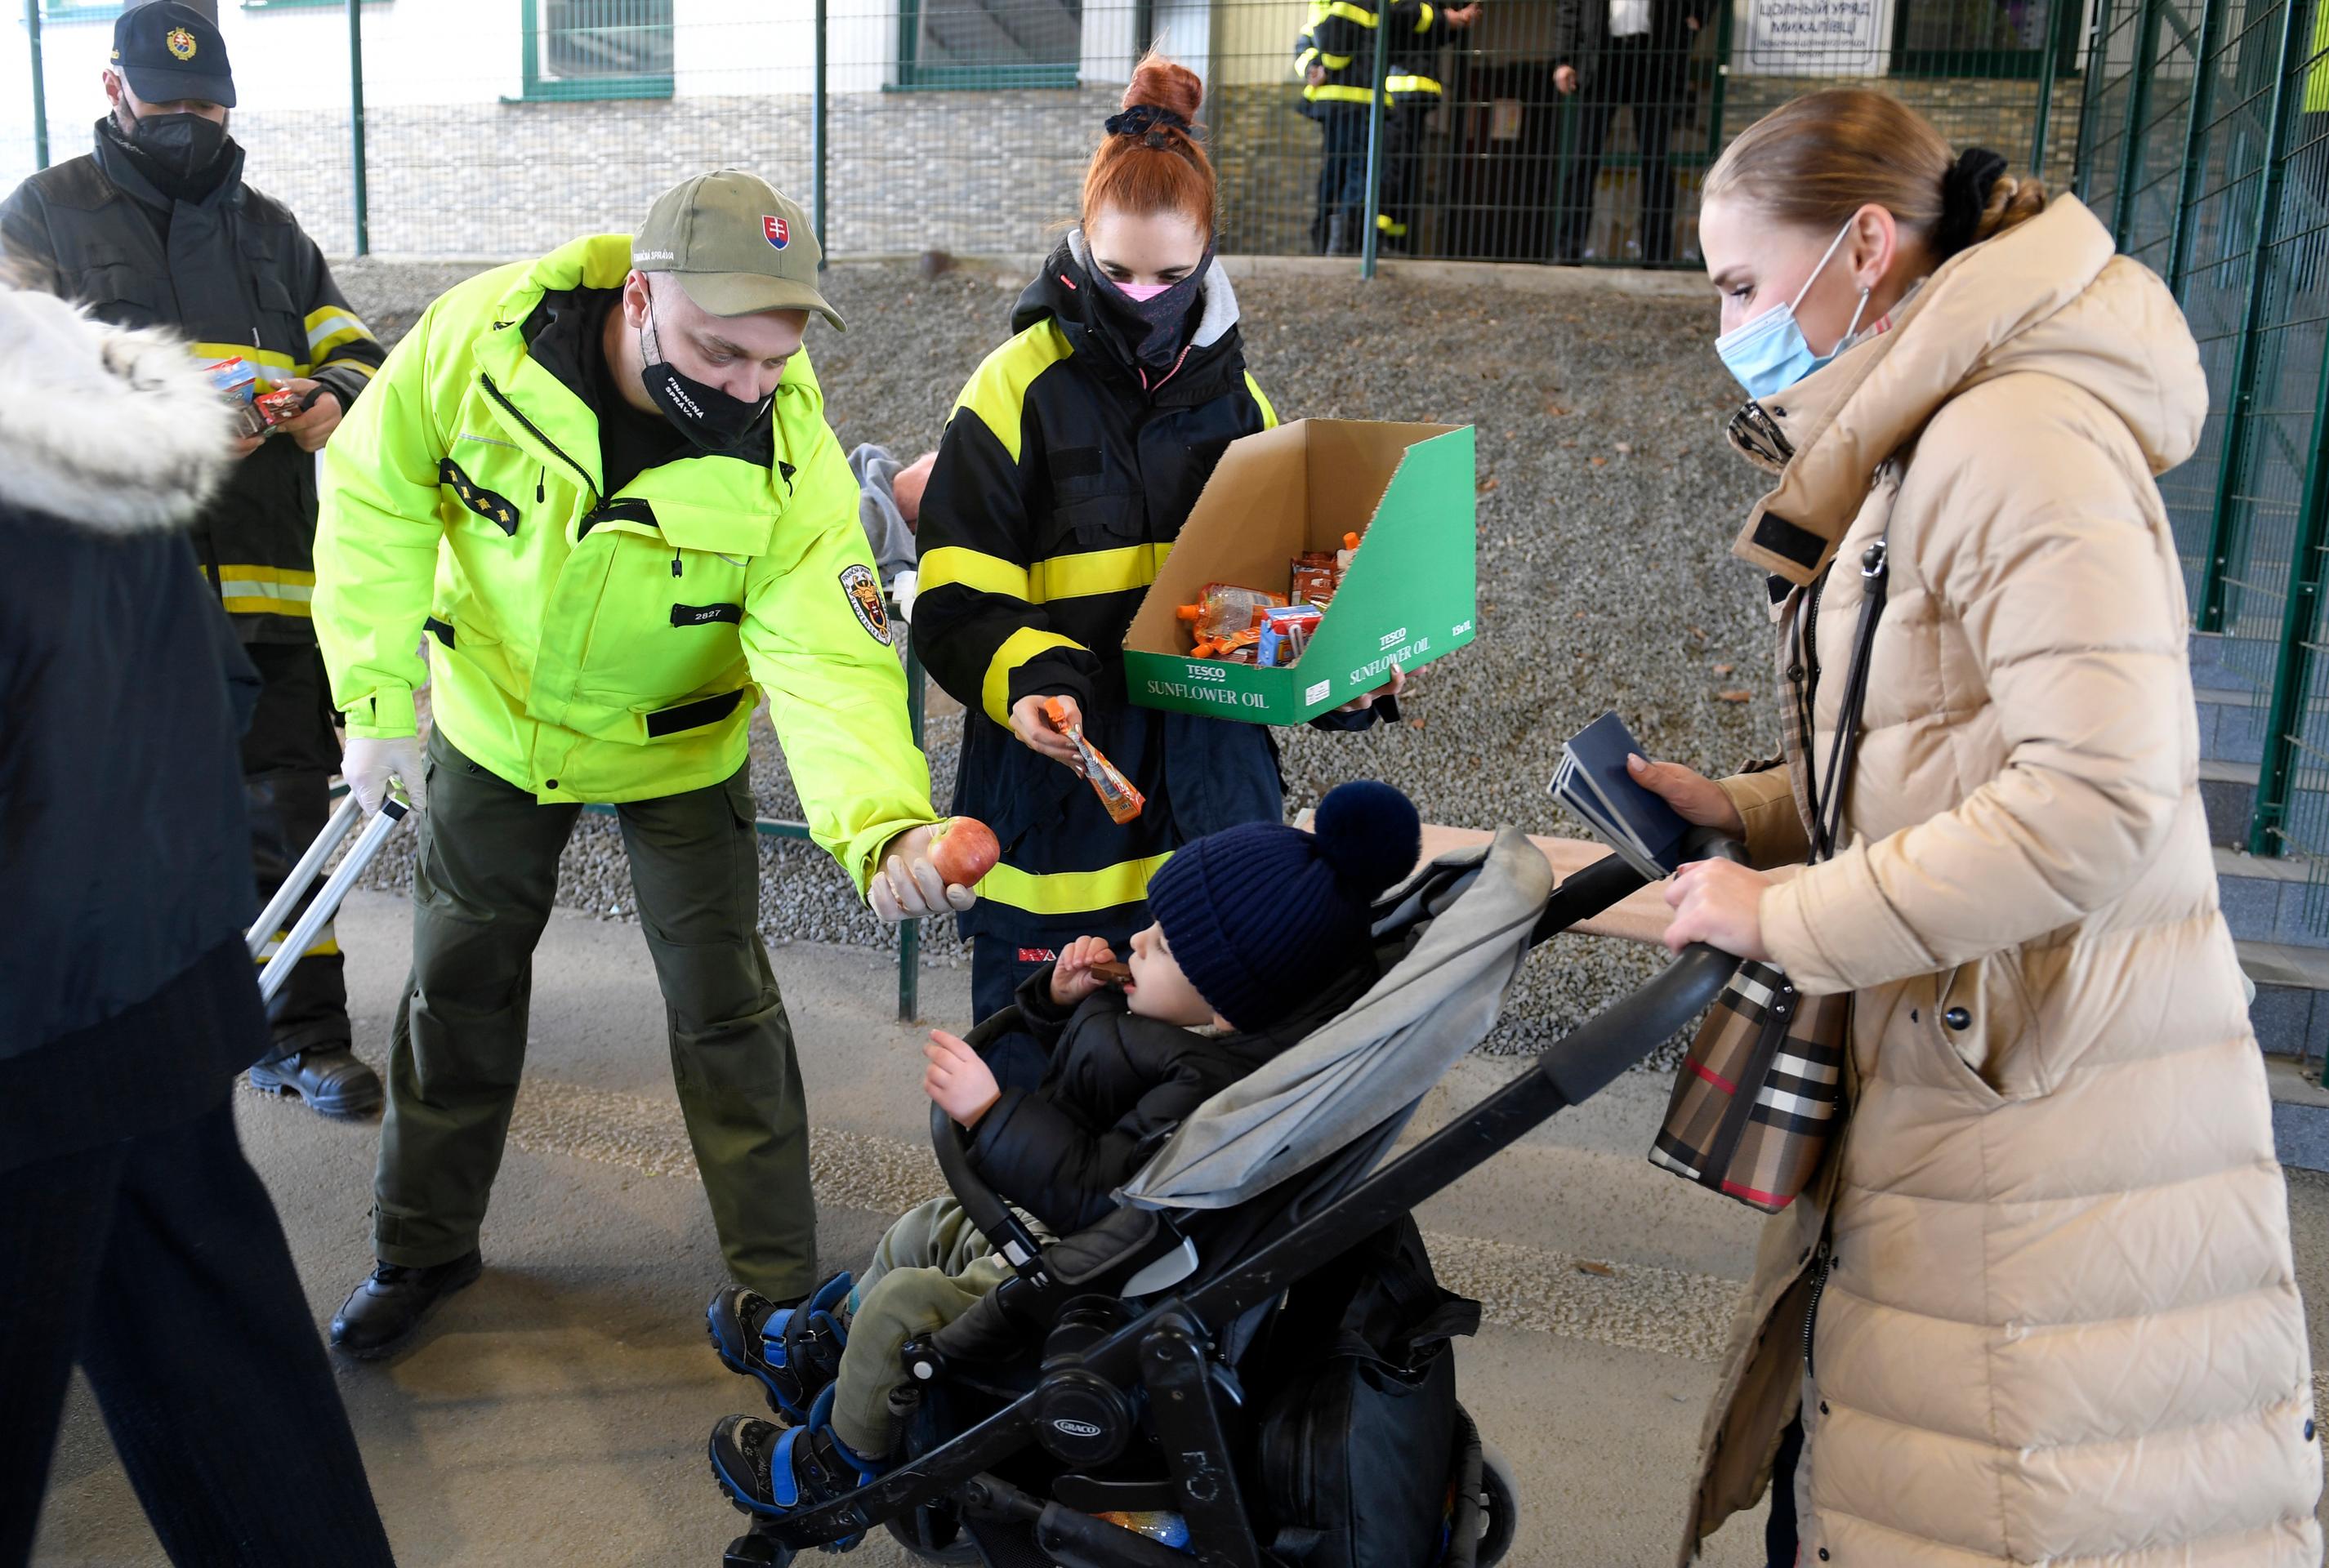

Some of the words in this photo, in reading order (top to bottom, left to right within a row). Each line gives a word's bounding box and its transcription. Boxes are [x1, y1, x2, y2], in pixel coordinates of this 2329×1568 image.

[651, 248, 674, 261] SPRÁVA
[665, 386, 693, 418] SPRÁVA
[667, 376, 704, 419] FINANČNÁ
[694, 609, 721, 620] 2827
[1379, 627, 1407, 646] TESCO
[1185, 664, 1225, 678] TESCO
[1350, 645, 1412, 686] SUNFLOWER
[1413, 637, 1430, 655] OIL
[1147, 679, 1238, 705] SUNFLOWER
[1242, 692, 1269, 709] OIL
[1060, 1422, 1096, 1434] GRACO
